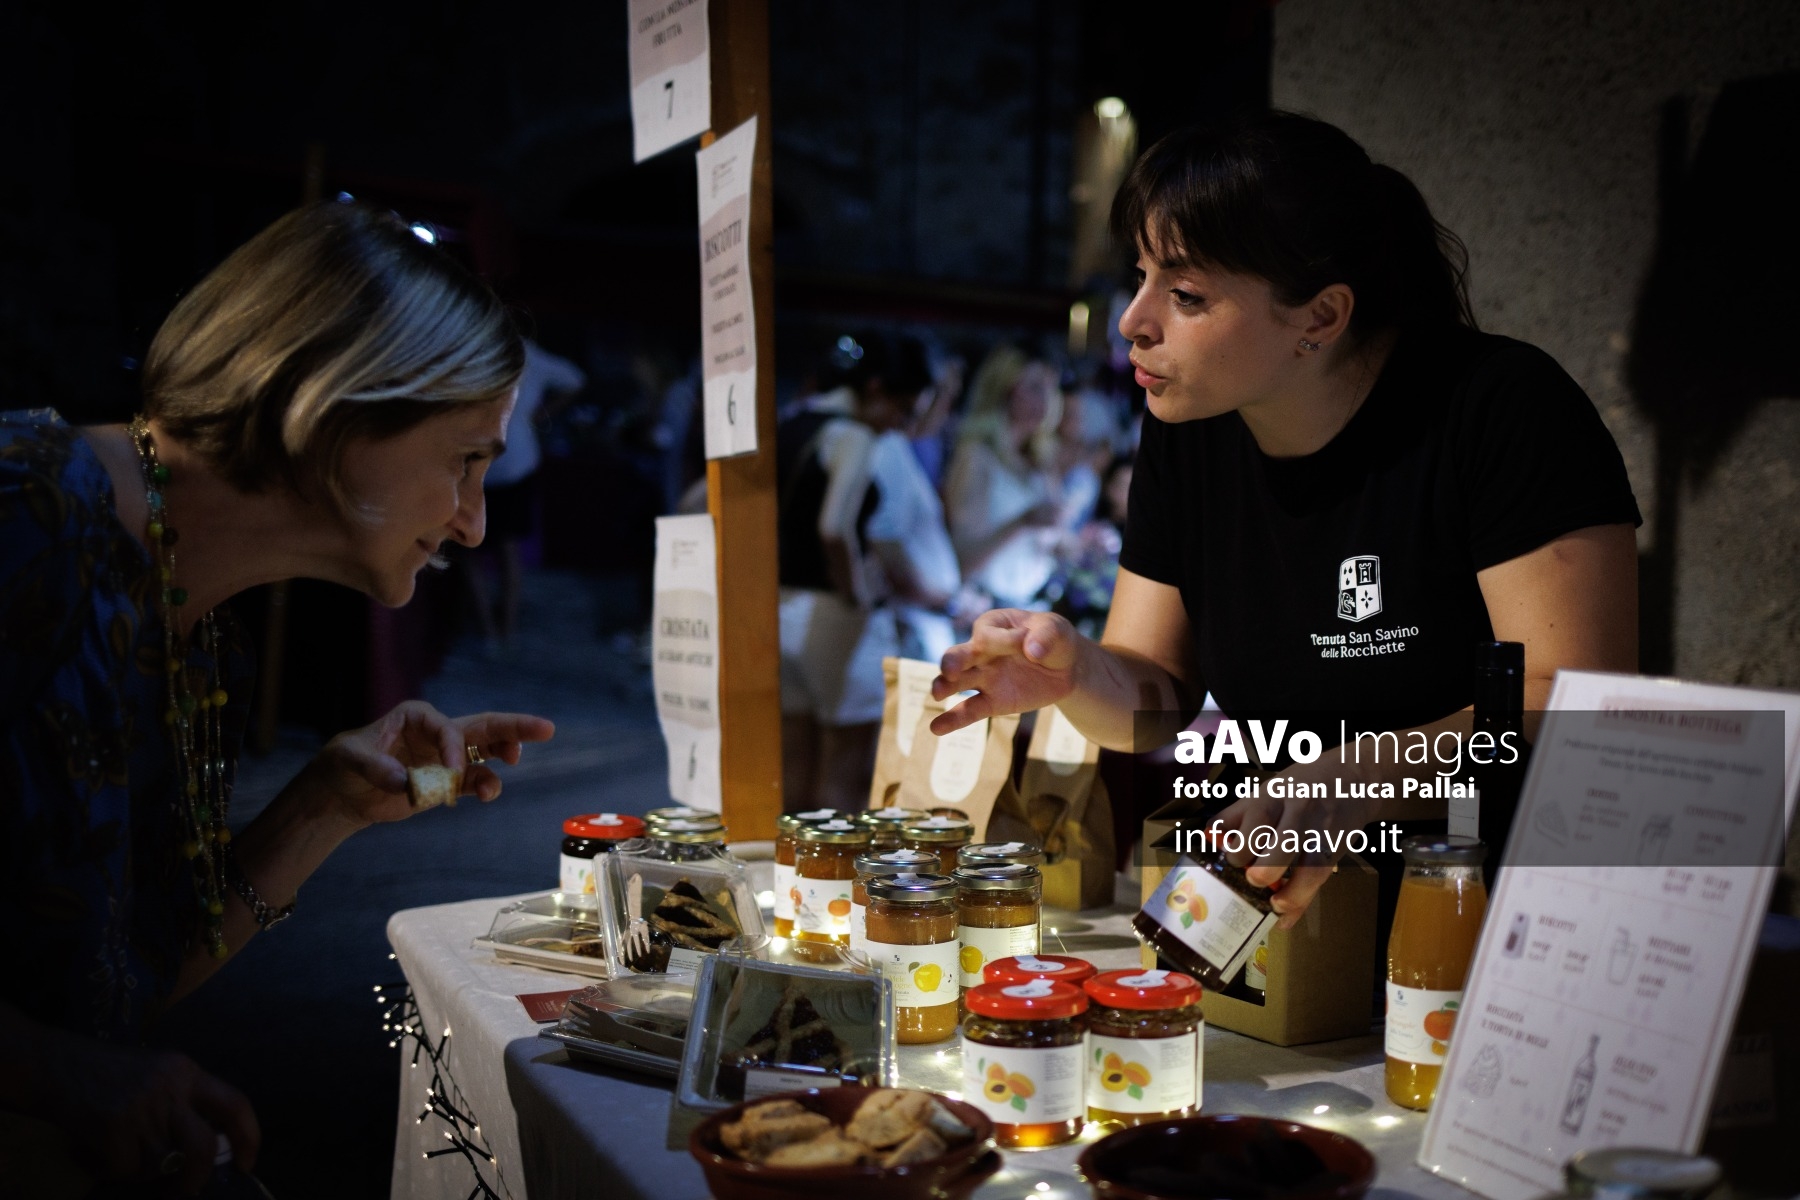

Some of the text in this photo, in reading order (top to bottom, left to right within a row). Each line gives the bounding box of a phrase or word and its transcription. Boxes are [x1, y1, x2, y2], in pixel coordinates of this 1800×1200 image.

[664, 79, 674, 119] 7
[728, 384, 737, 426] 6
[1310, 625, 1419, 646] Tenuta San Savino
[1321, 642, 1406, 658] delle Rocchette
[1623, 709, 1675, 728] NOSTRA
[1679, 713, 1742, 735] BOTTEGA
[1538, 915, 1577, 934] BISCOTTI
